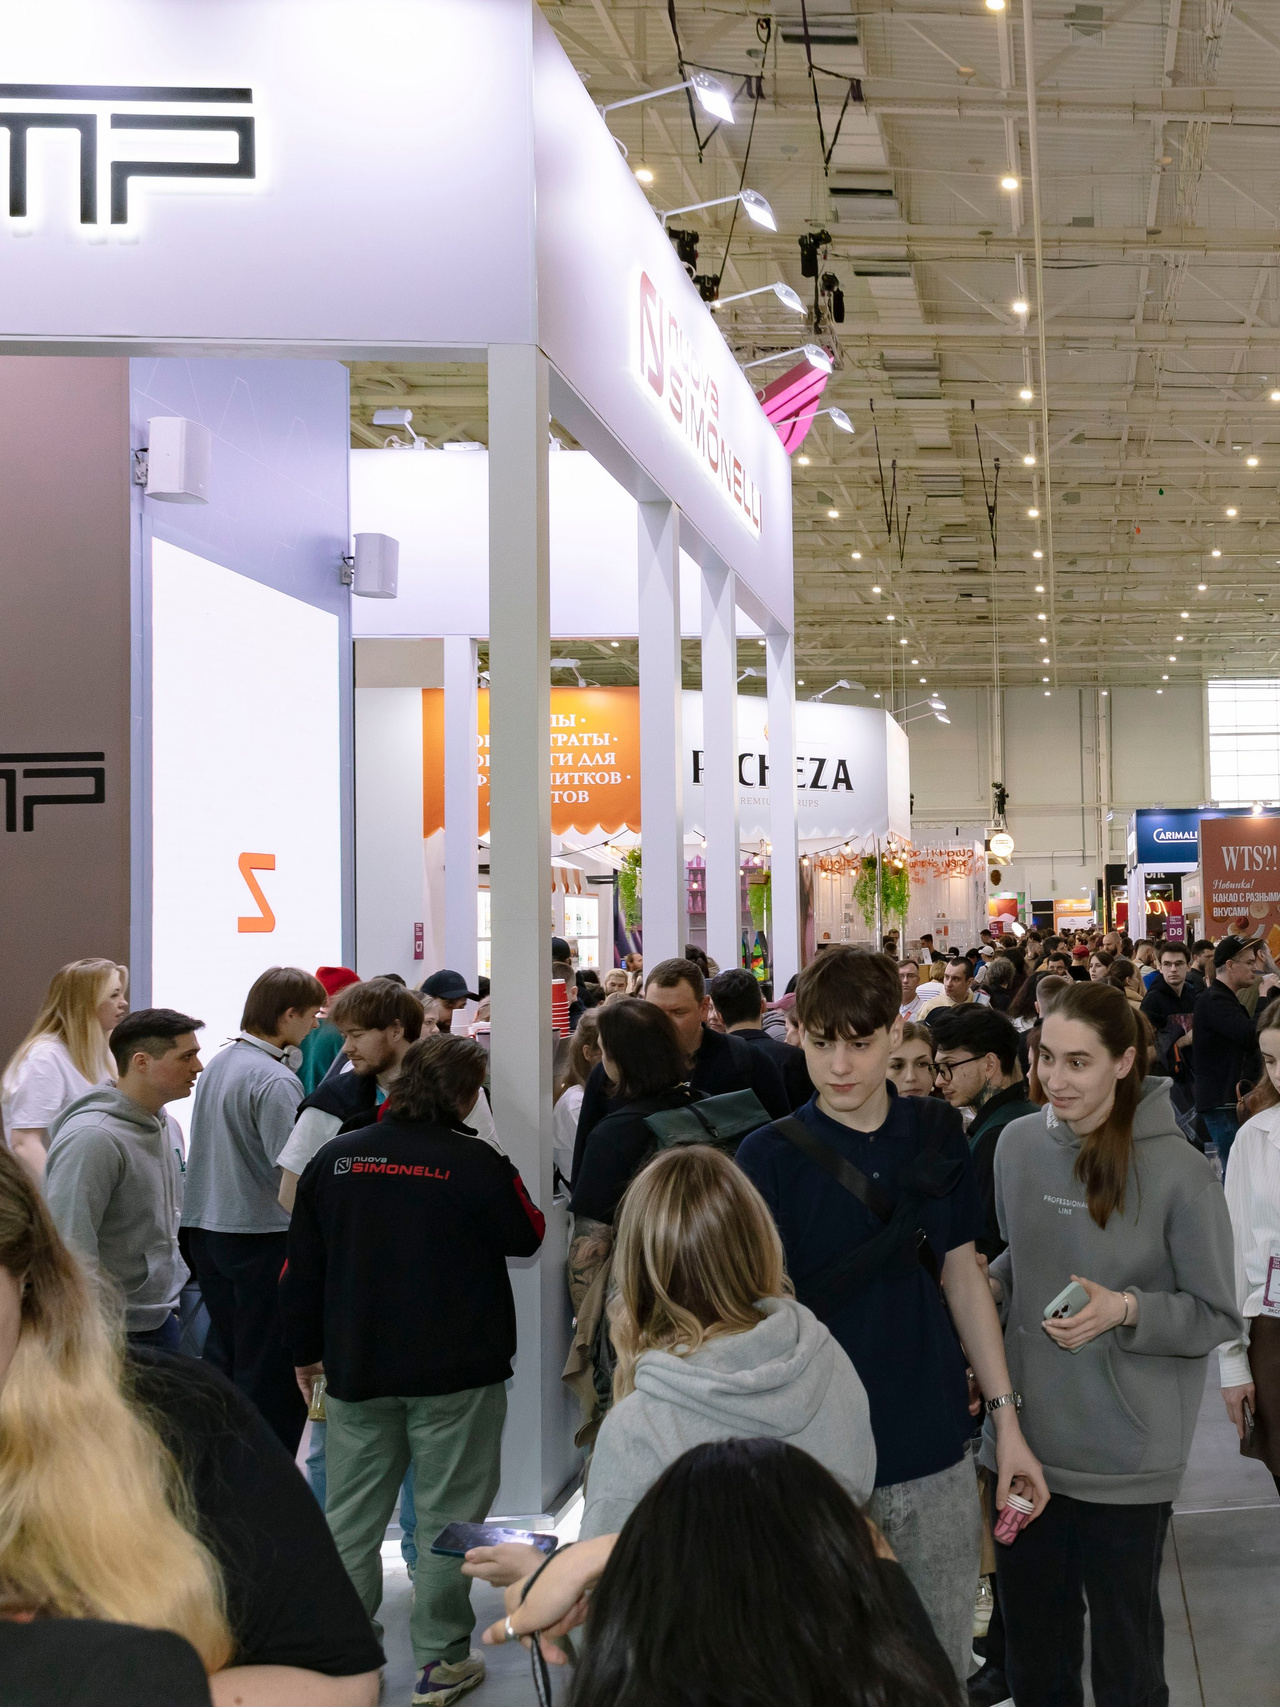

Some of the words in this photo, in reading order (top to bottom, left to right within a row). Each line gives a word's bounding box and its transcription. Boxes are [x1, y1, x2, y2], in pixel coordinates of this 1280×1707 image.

[668, 309, 719, 422] nuova
[669, 364, 764, 535] SIMONELLI
[578, 752, 616, 767] ДЛЯ
[1221, 845, 1278, 872] WTS?!
[1212, 878, 1255, 890] Новинка!
[1212, 893, 1238, 903] КАКАО
[1213, 906, 1249, 917] ВКУСАМИ
[1169, 926, 1183, 936] D8
[353, 1156, 388, 1164] nuova
[351, 1163, 451, 1180] SIMONELLI
[1043, 1194, 1088, 1208] PROFESSIONAL
[1058, 1207, 1072, 1215] LINE
